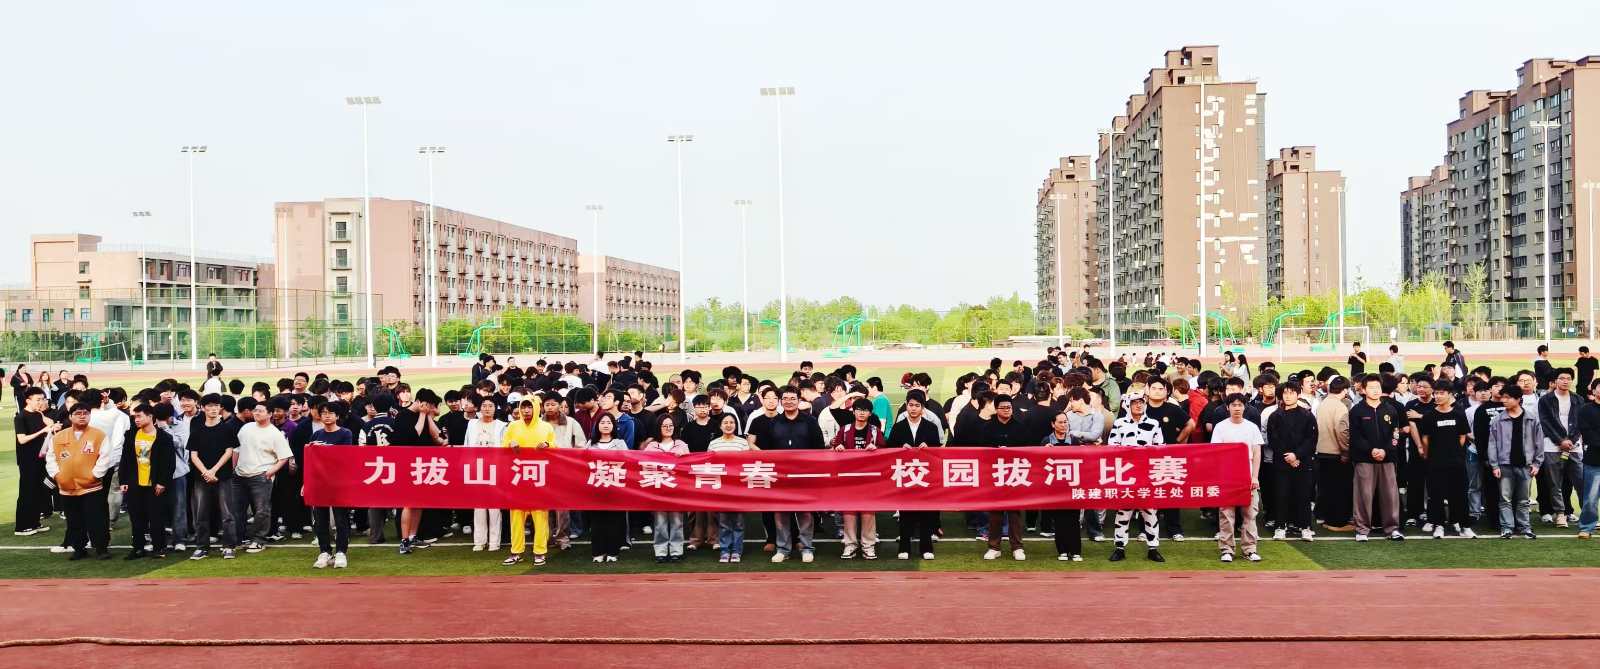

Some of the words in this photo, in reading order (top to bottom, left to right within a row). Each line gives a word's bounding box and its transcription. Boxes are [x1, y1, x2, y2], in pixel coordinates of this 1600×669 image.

[363, 456, 549, 486] 力拔山河
[1071, 486, 1184, 500] 陕建职大学生处
[1190, 485, 1221, 498] 团委
